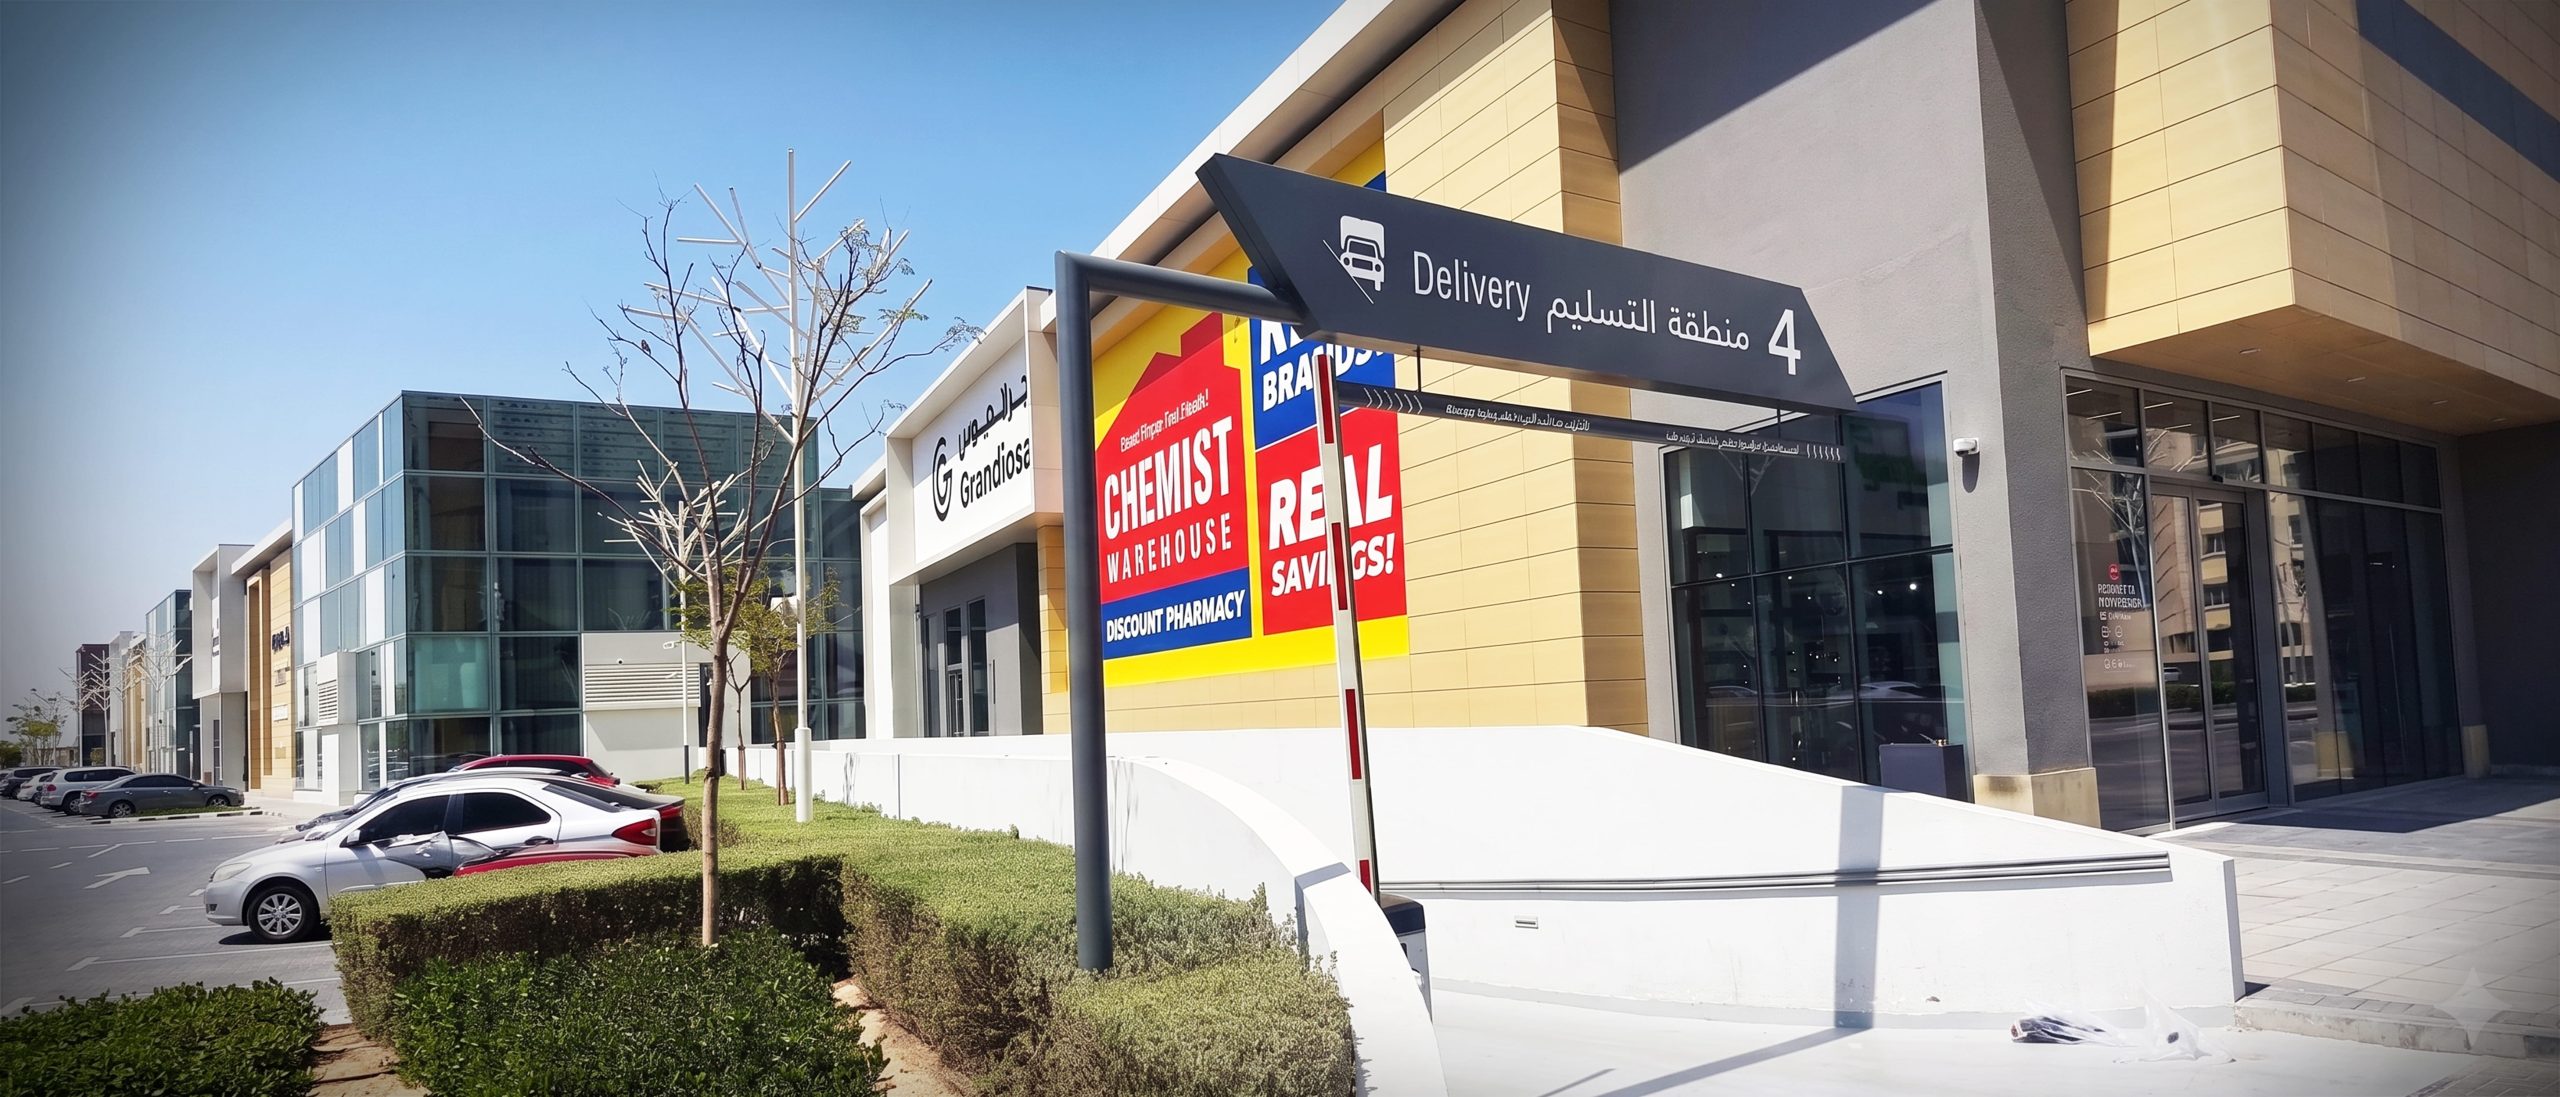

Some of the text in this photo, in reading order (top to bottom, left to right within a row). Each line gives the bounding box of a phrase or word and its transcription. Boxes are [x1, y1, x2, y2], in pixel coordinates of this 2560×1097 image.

[1412, 250, 1531, 322] Delivery
[1546, 289, 1750, 351] منطقة التسليم
[1767, 308, 1801, 376] 4
[1262, 342, 1385, 412] BRAD
[1104, 415, 1233, 540] CHEMIST
[1106, 512, 1232, 584] WAREHOUSE
[1271, 532, 1396, 597] SAVIGS!
[1106, 589, 1246, 643] DISCOUNT PHARMACY
